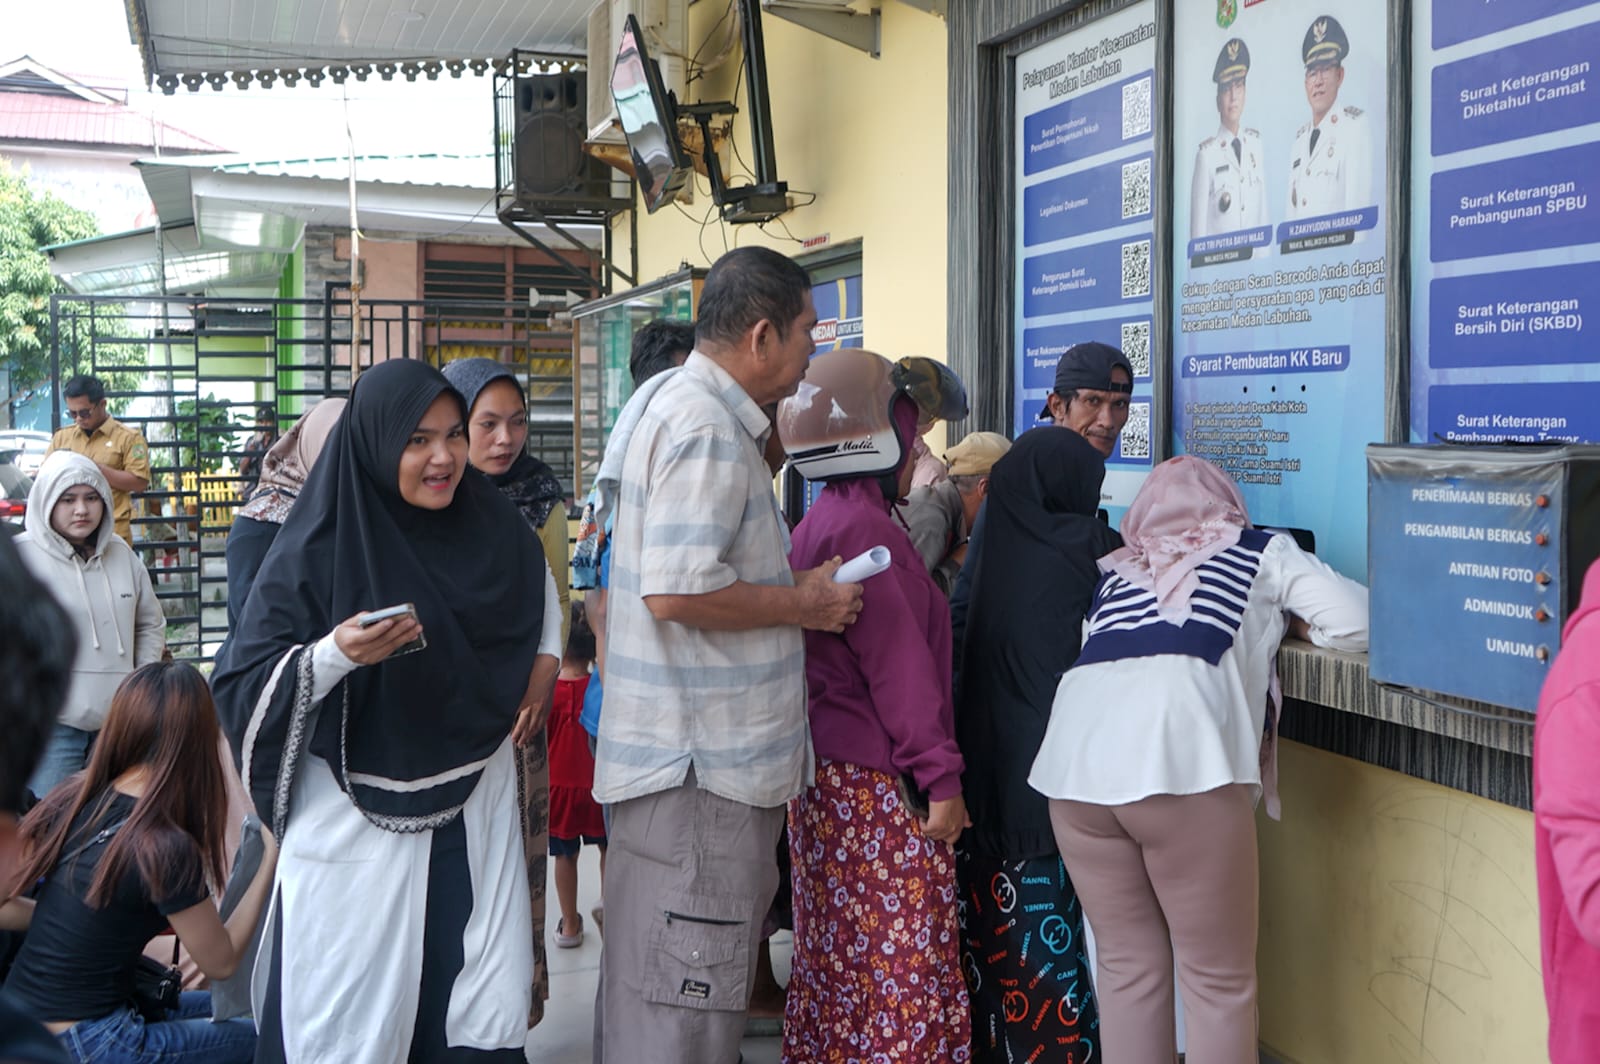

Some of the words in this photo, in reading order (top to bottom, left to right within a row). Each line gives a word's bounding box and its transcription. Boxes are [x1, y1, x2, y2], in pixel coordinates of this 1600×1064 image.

[1023, 61, 1066, 90] Pelayanan
[1067, 46, 1098, 70] Kantor
[1100, 23, 1156, 58] Kecamatan
[1050, 77, 1079, 99] Medan
[1080, 58, 1122, 85] Labuhan
[1460, 82, 1498, 102] Surat
[1501, 62, 1590, 93] Keterangan
[1463, 92, 1531, 119] Diketahui
[1535, 79, 1586, 102] Camat
[1460, 194, 1494, 210] Surat
[1497, 181, 1576, 204] Keterangan
[1332, 214, 1363, 229] HARAHAP
[1450, 204, 1542, 229] Pembangunan
[1546, 195, 1588, 214] SPBU
[1214, 238, 1233, 249] PUTRA
[1182, 282, 1210, 298] Cukup
[1212, 278, 1246, 296] dengan
[1248, 273, 1273, 290] Scan
[1274, 268, 1318, 287] Barcode
[1319, 263, 1349, 281] Anda
[1351, 258, 1385, 277] dapat
[1181, 298, 1233, 317] mengetahui
[1235, 291, 1293, 312] persyaratan
[1294, 290, 1315, 306] apa
[1318, 286, 1347, 304] yang
[1349, 281, 1371, 298] ada
[1373, 279, 1385, 296] di
[1458, 303, 1493, 318] Surat
[1497, 299, 1579, 316] Keterangan
[1182, 316, 1229, 333] kecamatan
[1231, 312, 1262, 328] Medan
[1263, 308, 1312, 325] Labuhan.
[1455, 320, 1497, 336] Bersih
[1501, 318, 1525, 333] Diri
[1528, 314, 1583, 334] (SKBD)
[1189, 356, 1223, 376] Syarat
[1224, 353, 1287, 371] Pembuatan
[1290, 350, 1309, 367] KK
[1312, 349, 1343, 366] Baru
[1457, 414, 1490, 428] Surat
[1492, 414, 1567, 431] Keterangan
[1258, 430, 1271, 441] KK
[1271, 430, 1289, 442] baru
[1246, 444, 1268, 456] Nikah
[1260, 459, 1283, 470] Suami
[1243, 472, 1266, 483] Suami
[1412, 488, 1485, 505] PENERIMAAN
[1487, 492, 1532, 507] BERKAS
[1405, 523, 1484, 541] PENGAMBILAN
[1487, 529, 1532, 545] BERKAS
[1449, 562, 1500, 580] ANTRIAN
[1502, 567, 1534, 584] FOTO
[1464, 598, 1533, 620] ADMINDUK
[1486, 637, 1534, 659] UMUM
[1021, 876, 1051, 885] CANNEL
[1024, 902, 1055, 912] CANNEL
[1019, 930, 1032, 967] CANNEL
[1032, 998, 1052, 1031] CANNEL
